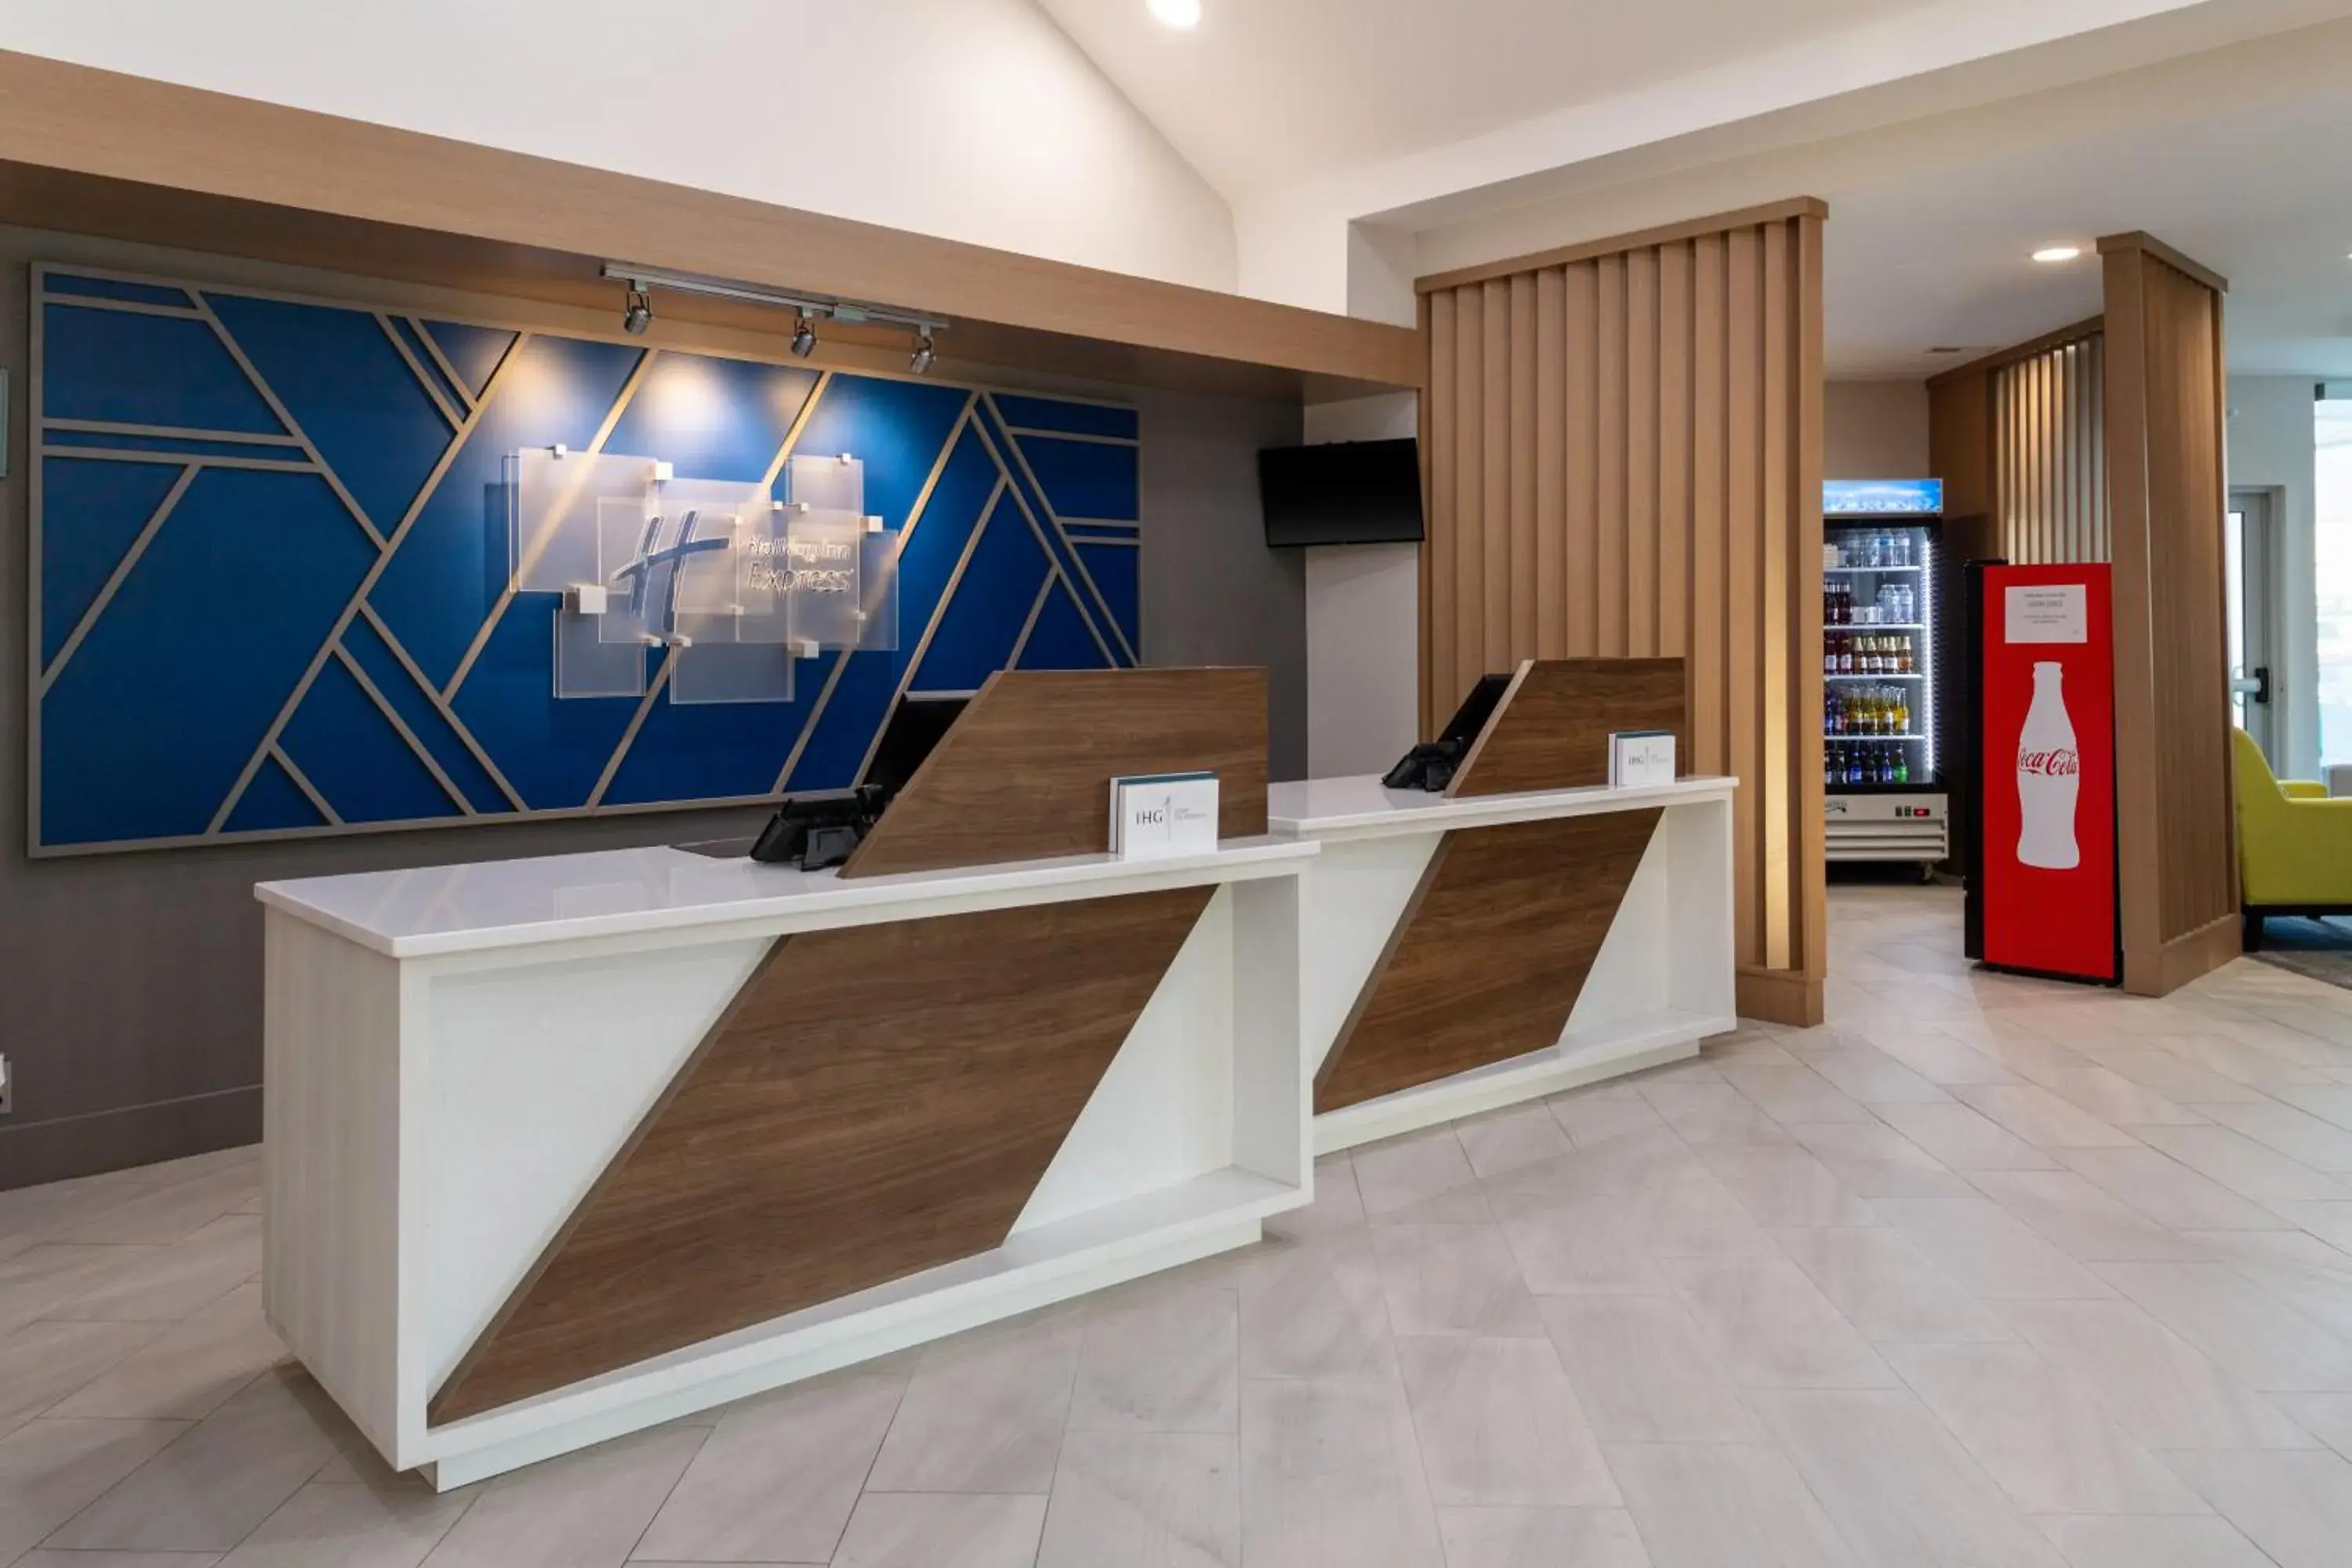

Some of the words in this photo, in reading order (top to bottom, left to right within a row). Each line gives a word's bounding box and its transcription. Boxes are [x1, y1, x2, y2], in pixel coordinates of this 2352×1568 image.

[748, 560, 852, 598] Express
[2020, 747, 2077, 775] oca-Cola
[1136, 809, 1163, 825] IHG
